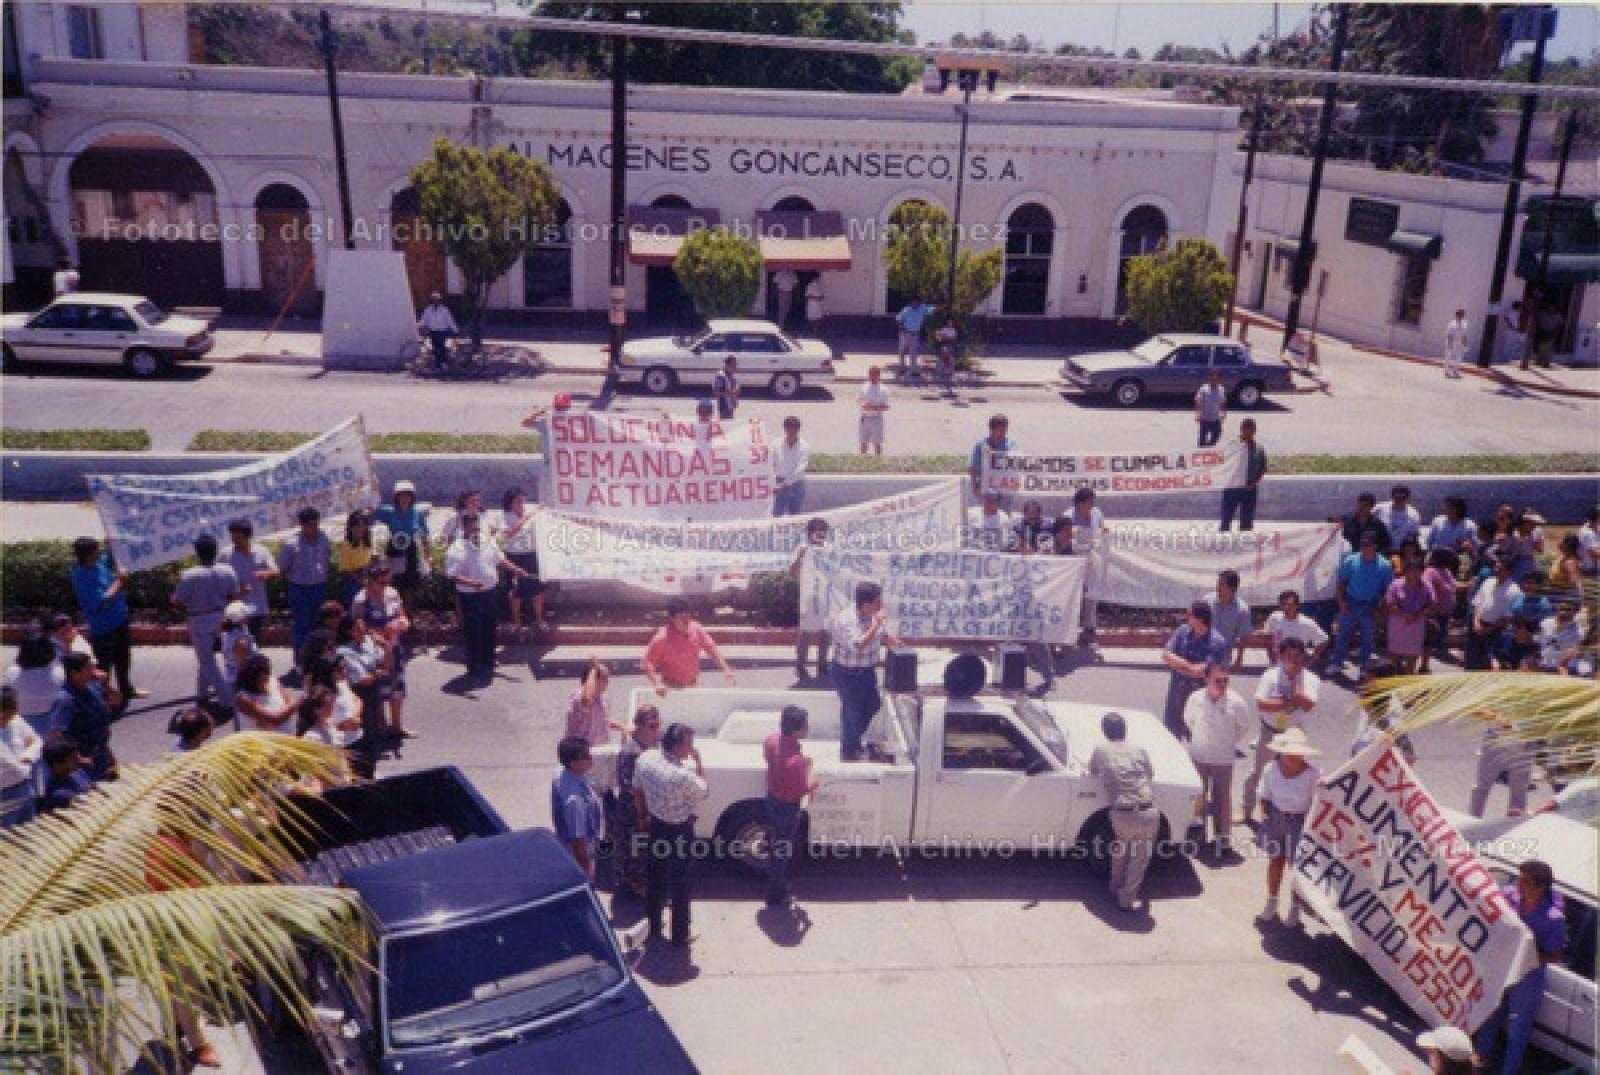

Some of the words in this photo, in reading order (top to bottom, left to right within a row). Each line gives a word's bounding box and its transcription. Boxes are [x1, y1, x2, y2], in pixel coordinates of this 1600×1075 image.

[556, 448, 732, 478] DEMANDAS
[992, 456, 1075, 473] EXIGIMOS
[1084, 456, 1105, 471] SE
[1111, 454, 1187, 473] CUMPLA
[1191, 451, 1225, 467] CON
[586, 476, 769, 507] ACTUAREMOS
[988, 475, 1019, 492] LAS
[1112, 473, 1212, 492] ECONOMICAS
[1311, 799, 1377, 868] 15%
[1380, 861, 1406, 892] Y
[1369, 749, 1503, 925] EXIGIMOS
[1325, 770, 1489, 953] AUMENTO
